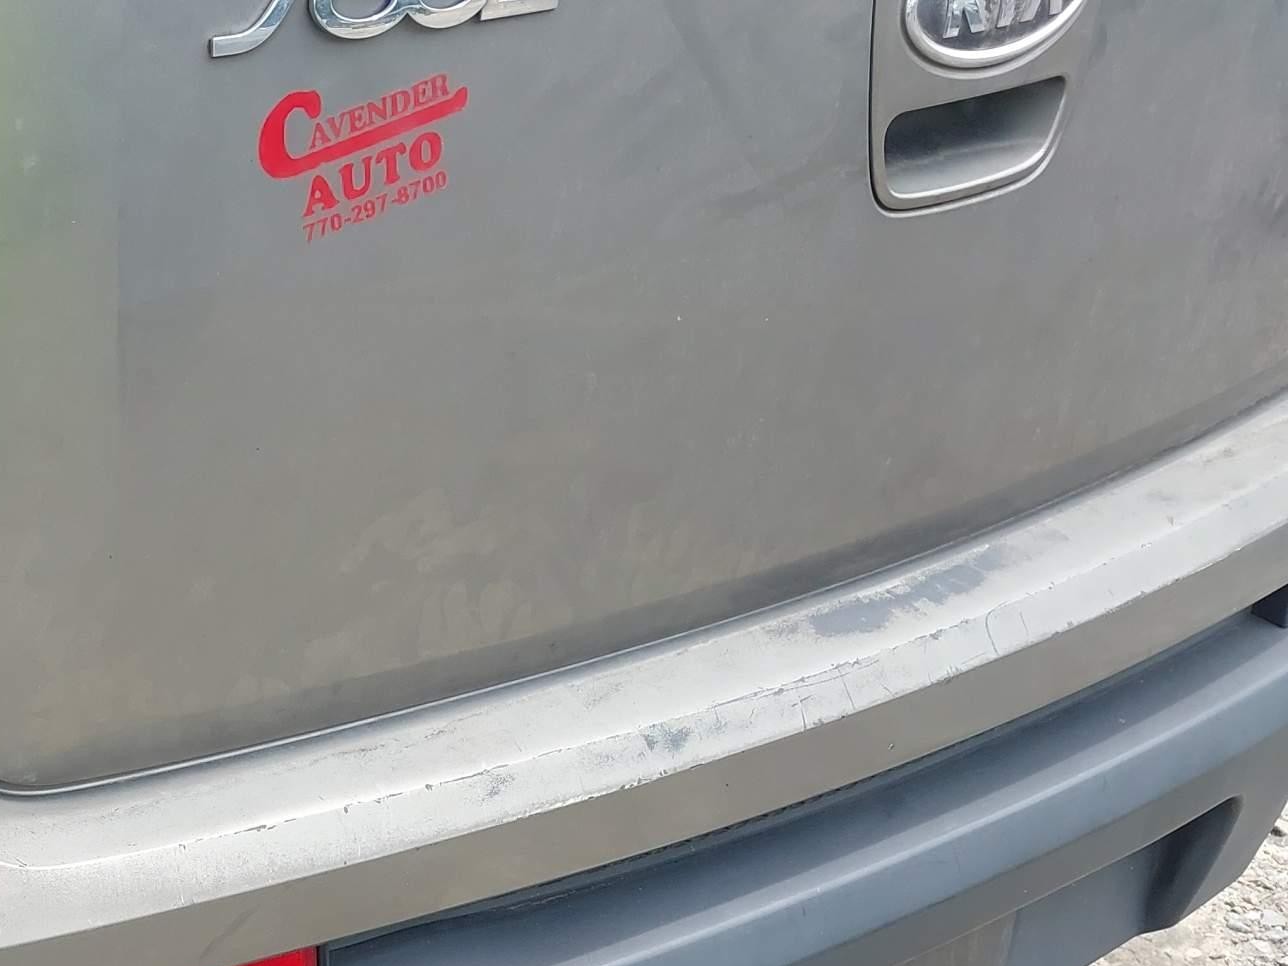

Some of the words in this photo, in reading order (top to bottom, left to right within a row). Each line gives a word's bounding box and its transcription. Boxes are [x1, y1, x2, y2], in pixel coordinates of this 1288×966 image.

[259, 73, 469, 180] CAVENDER
[302, 170, 448, 242] 770-297-8700
[303, 131, 443, 217] AUTO
